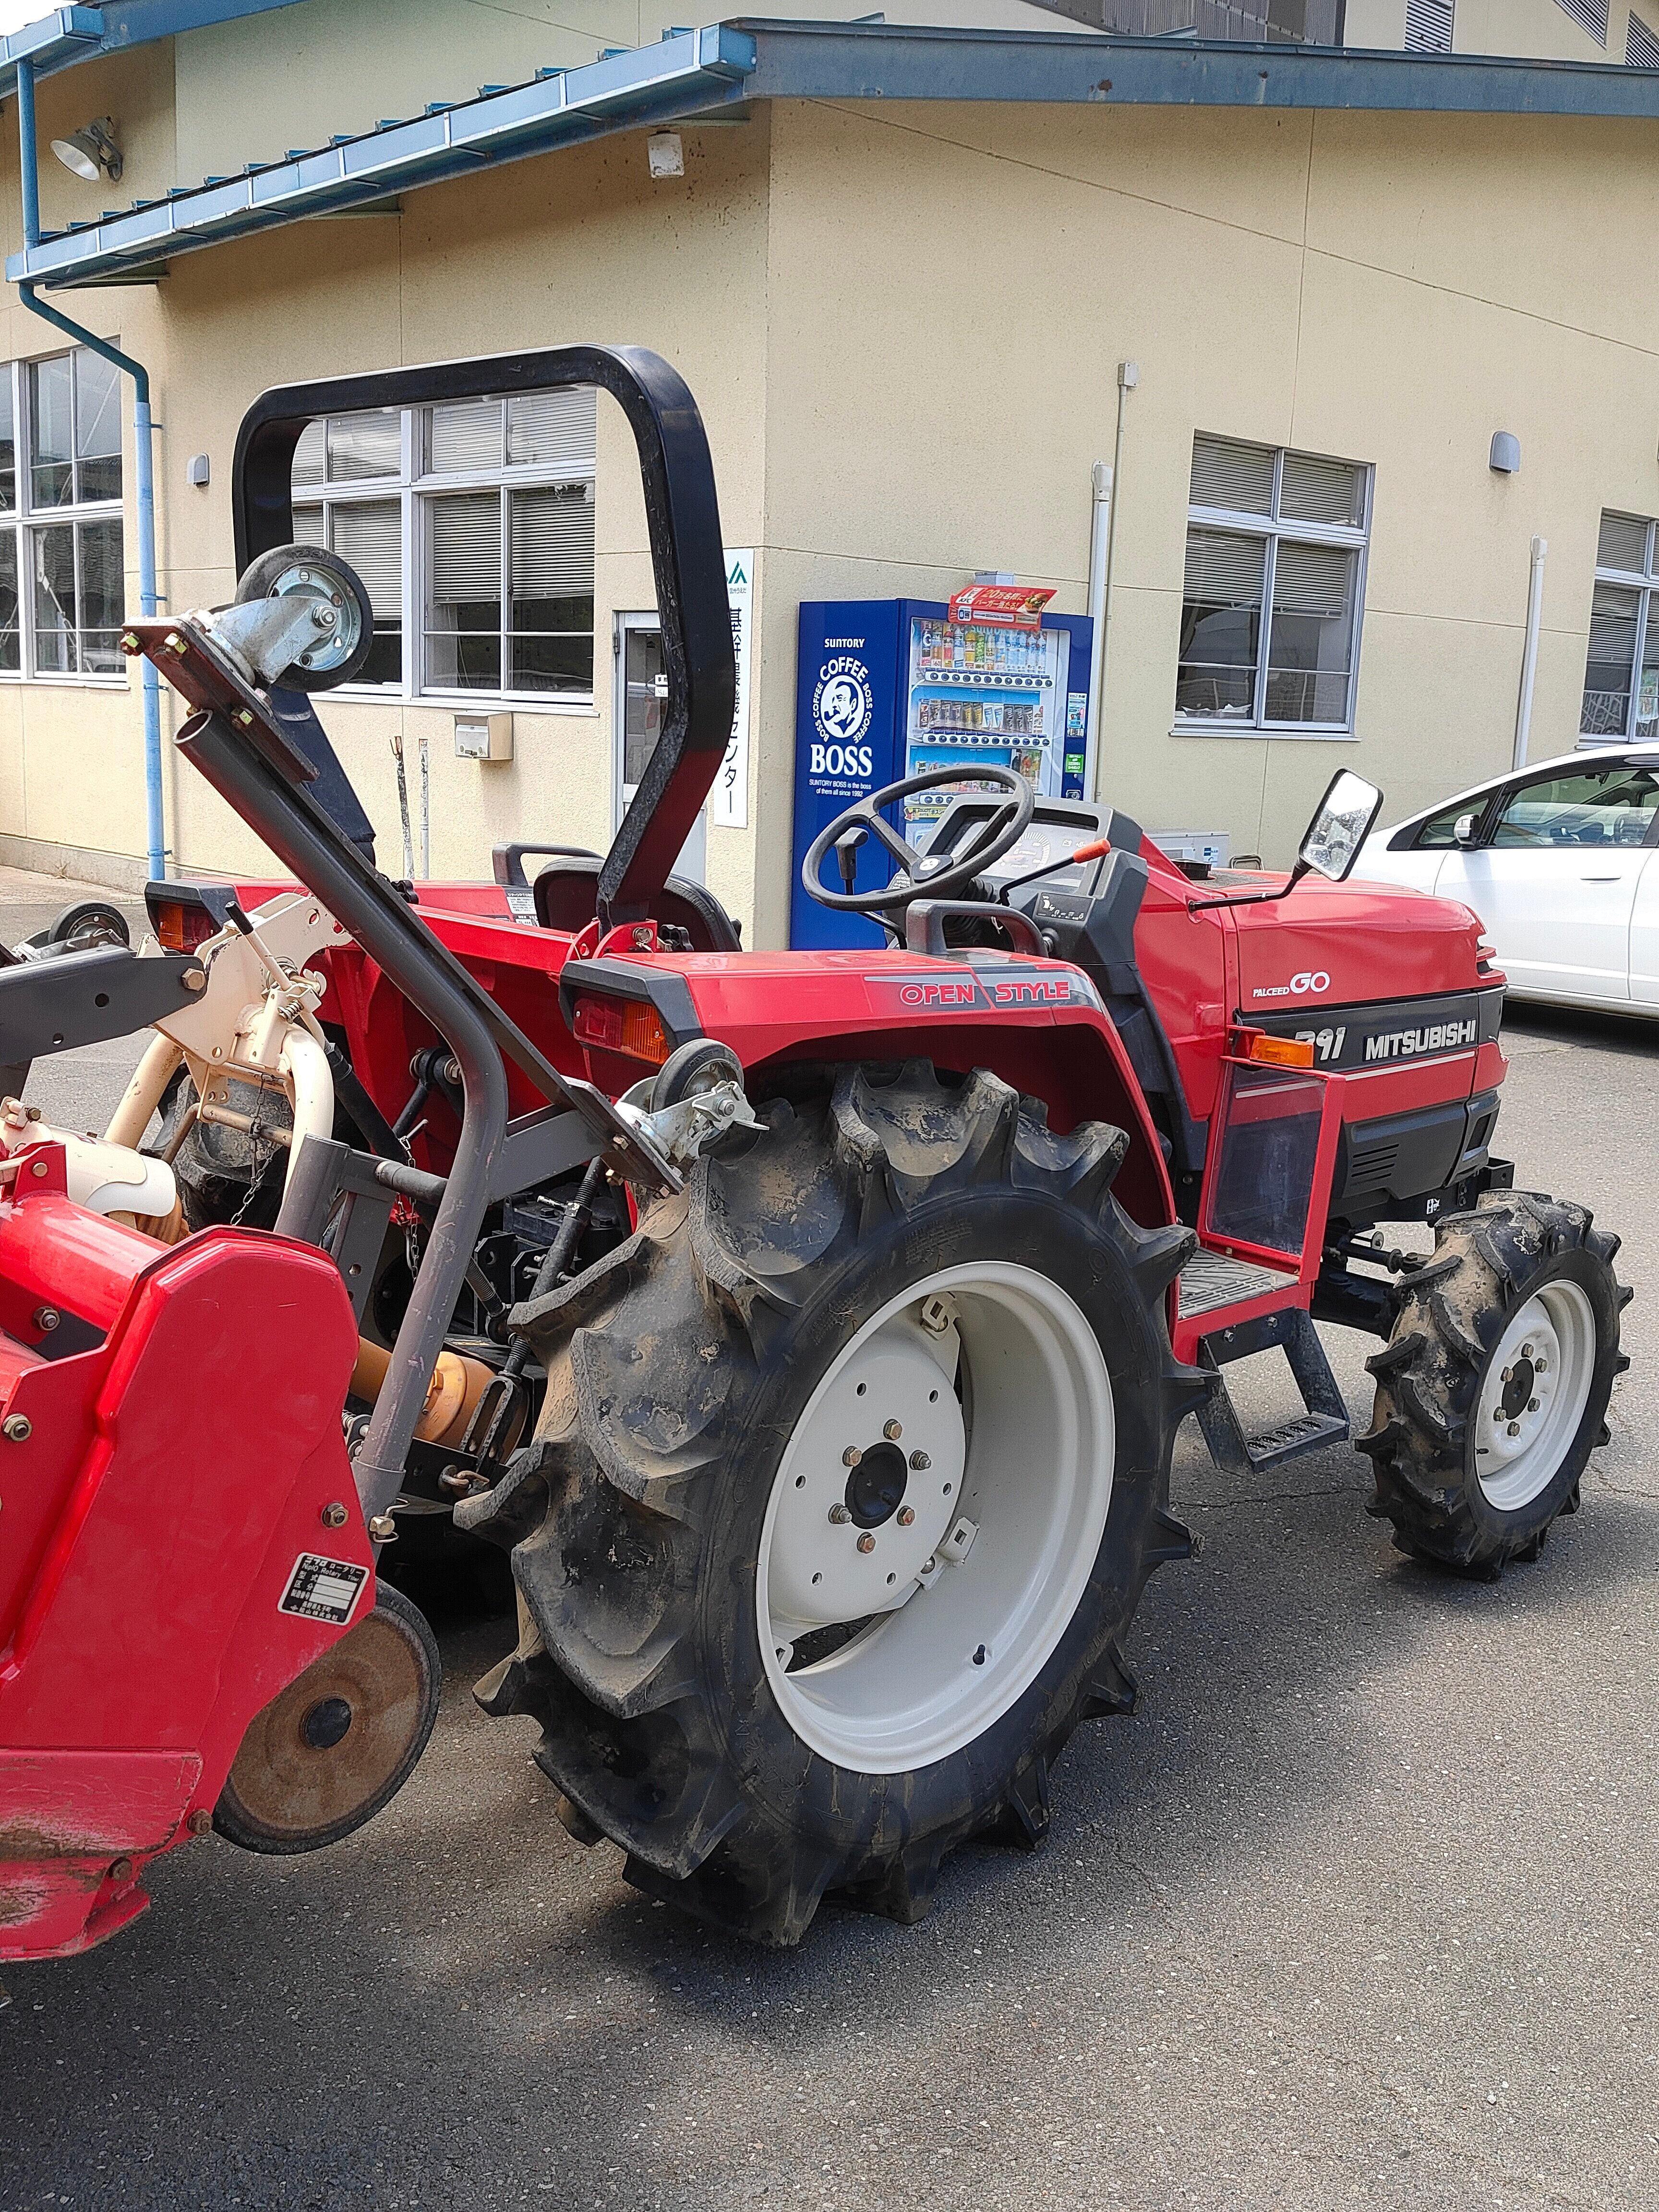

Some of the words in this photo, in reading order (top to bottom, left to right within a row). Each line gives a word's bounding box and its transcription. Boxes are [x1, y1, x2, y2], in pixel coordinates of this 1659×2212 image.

[825, 638, 865, 648] SUNTORY
[820, 656, 868, 683] COFFEE
[813, 682, 824, 718] COFFEE
[862, 683, 873, 709] BOSS
[815, 720, 830, 742] BOSS
[852, 711, 872, 744] COFFEE
[809, 744, 872, 777] BOSS
[809, 779, 832, 787] SUNTORY
[901, 984, 975, 1005] OPEN
[995, 981, 1070, 1002] STYLE
[1253, 986, 1289, 998] PALCEED
[1290, 971, 1330, 994] GO
[1365, 1019, 1476, 1061] MITSUBISHI
[320, 1567, 342, 1578] Rotary
[329, 1563, 362, 1575] ロータリー
